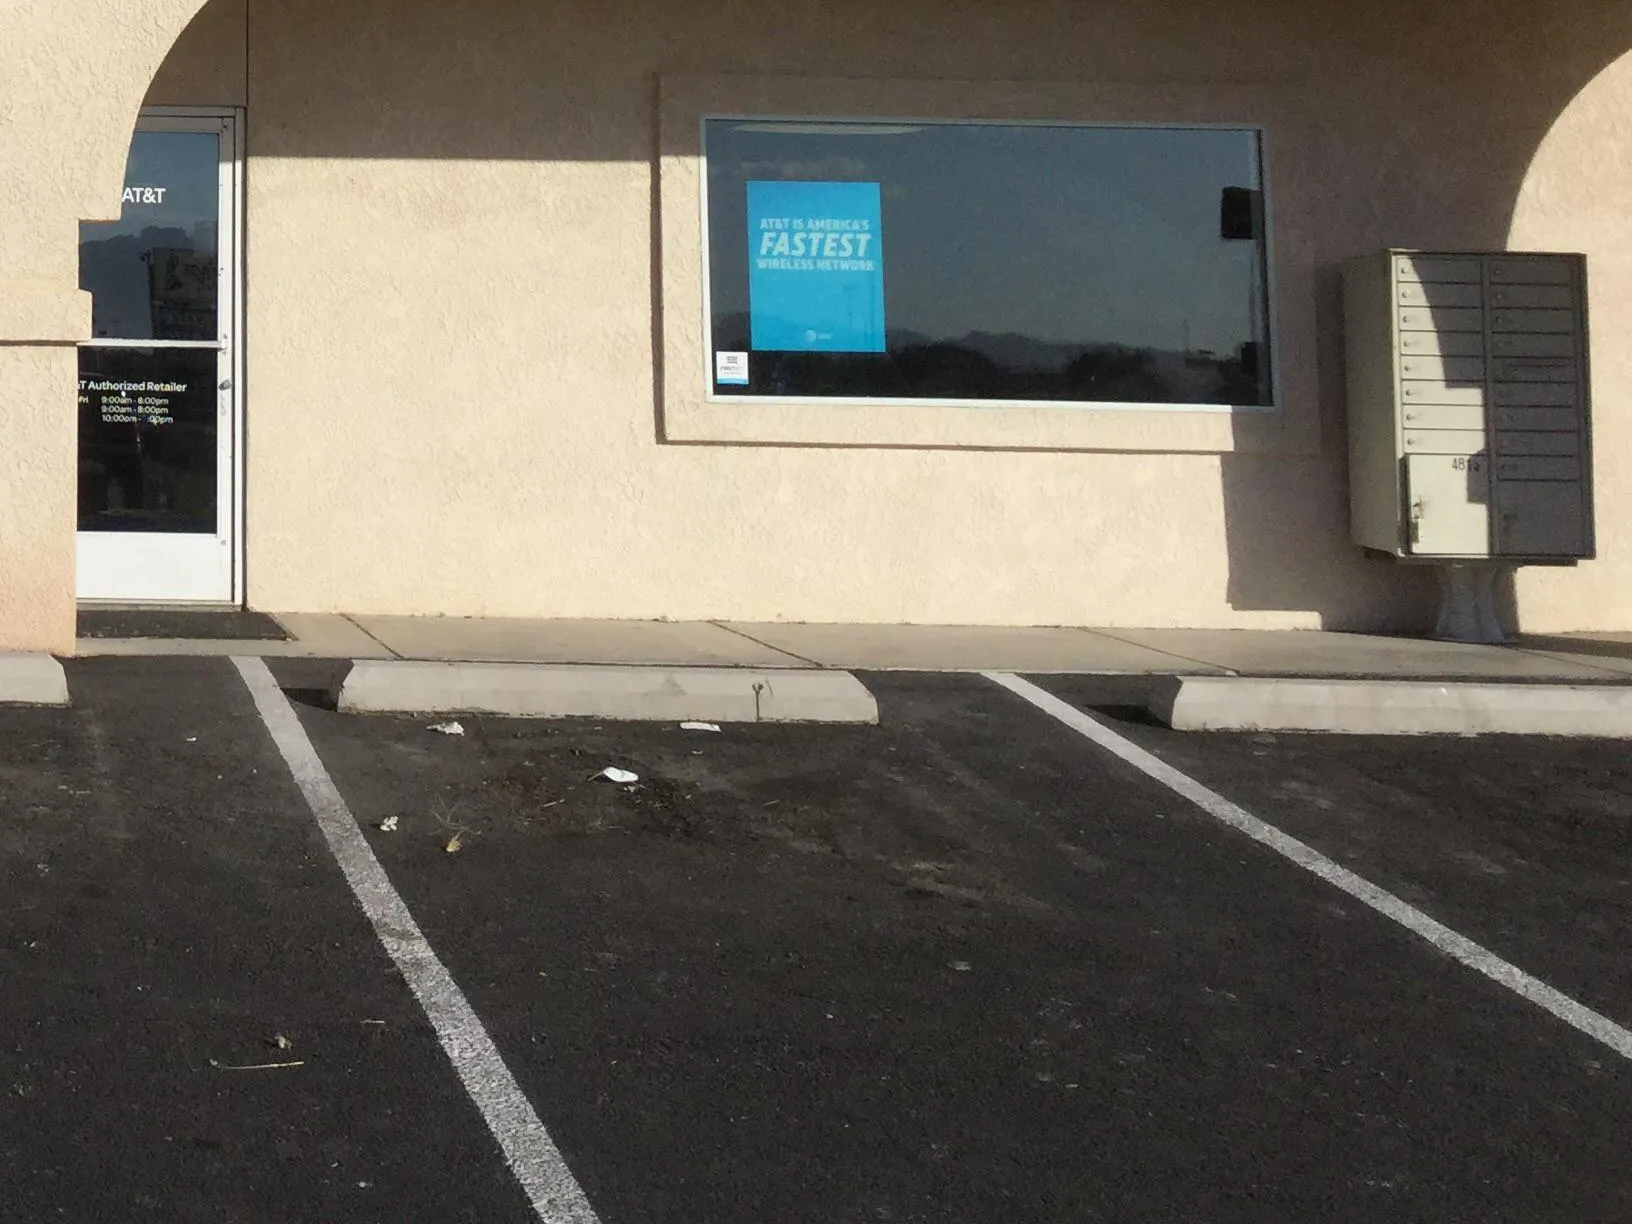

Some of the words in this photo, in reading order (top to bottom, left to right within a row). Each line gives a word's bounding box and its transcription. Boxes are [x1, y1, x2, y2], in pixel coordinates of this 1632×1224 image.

[121, 187, 166, 204] AT&T
[793, 218, 805, 229] IS
[759, 231, 872, 257] FASTEST
[756, 257, 814, 270] WIRELESS
[816, 259, 876, 272] NETWORK
[88, 380, 146, 391] Authorized
[147, 381, 188, 393] Retailer
